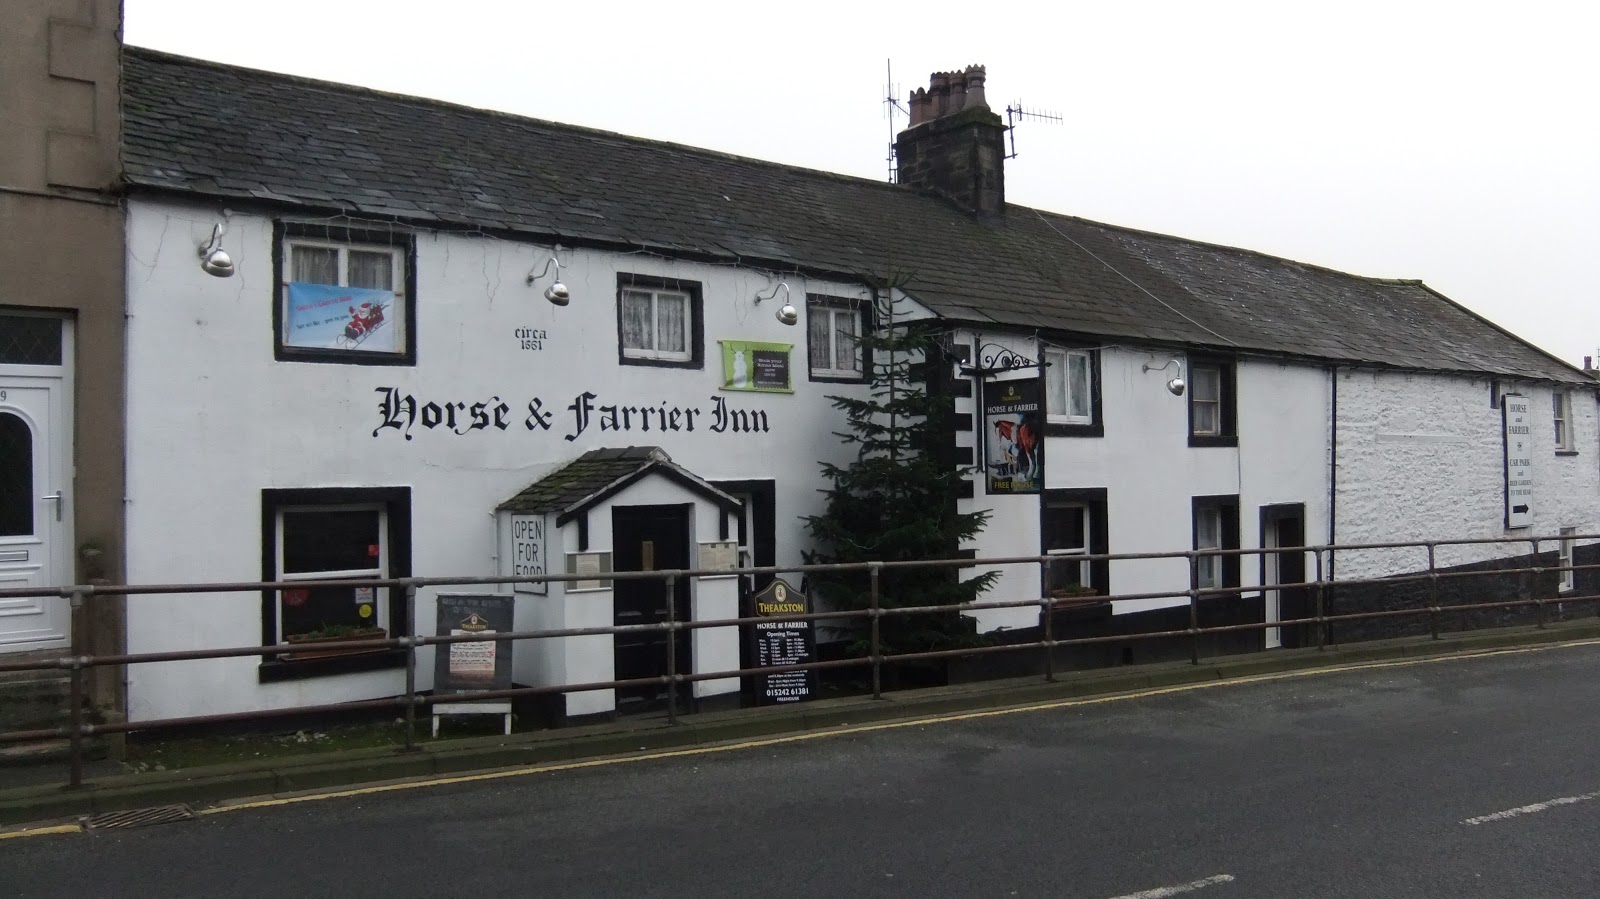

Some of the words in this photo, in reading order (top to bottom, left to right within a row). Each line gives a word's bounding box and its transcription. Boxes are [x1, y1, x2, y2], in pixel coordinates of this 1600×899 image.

[514, 325, 547, 339] circa
[521, 339, 542, 350] 1661
[373, 387, 511, 440] Horse
[525, 397, 553, 431] &
[565, 388, 700, 442] Farrier
[709, 396, 770, 433] Inn
[987, 406, 1006, 414] HORSE
[1014, 404, 1038, 412] FARRIER
[1510, 404, 1527, 414] HORSE
[1508, 426, 1530, 434] FARRIER
[1519, 458, 1530, 466] PARK
[514, 520, 542, 540] OPEN
[518, 542, 538, 562] FOR
[758, 602, 804, 613] THEAKSTON
[766, 688, 790, 696] 015242
